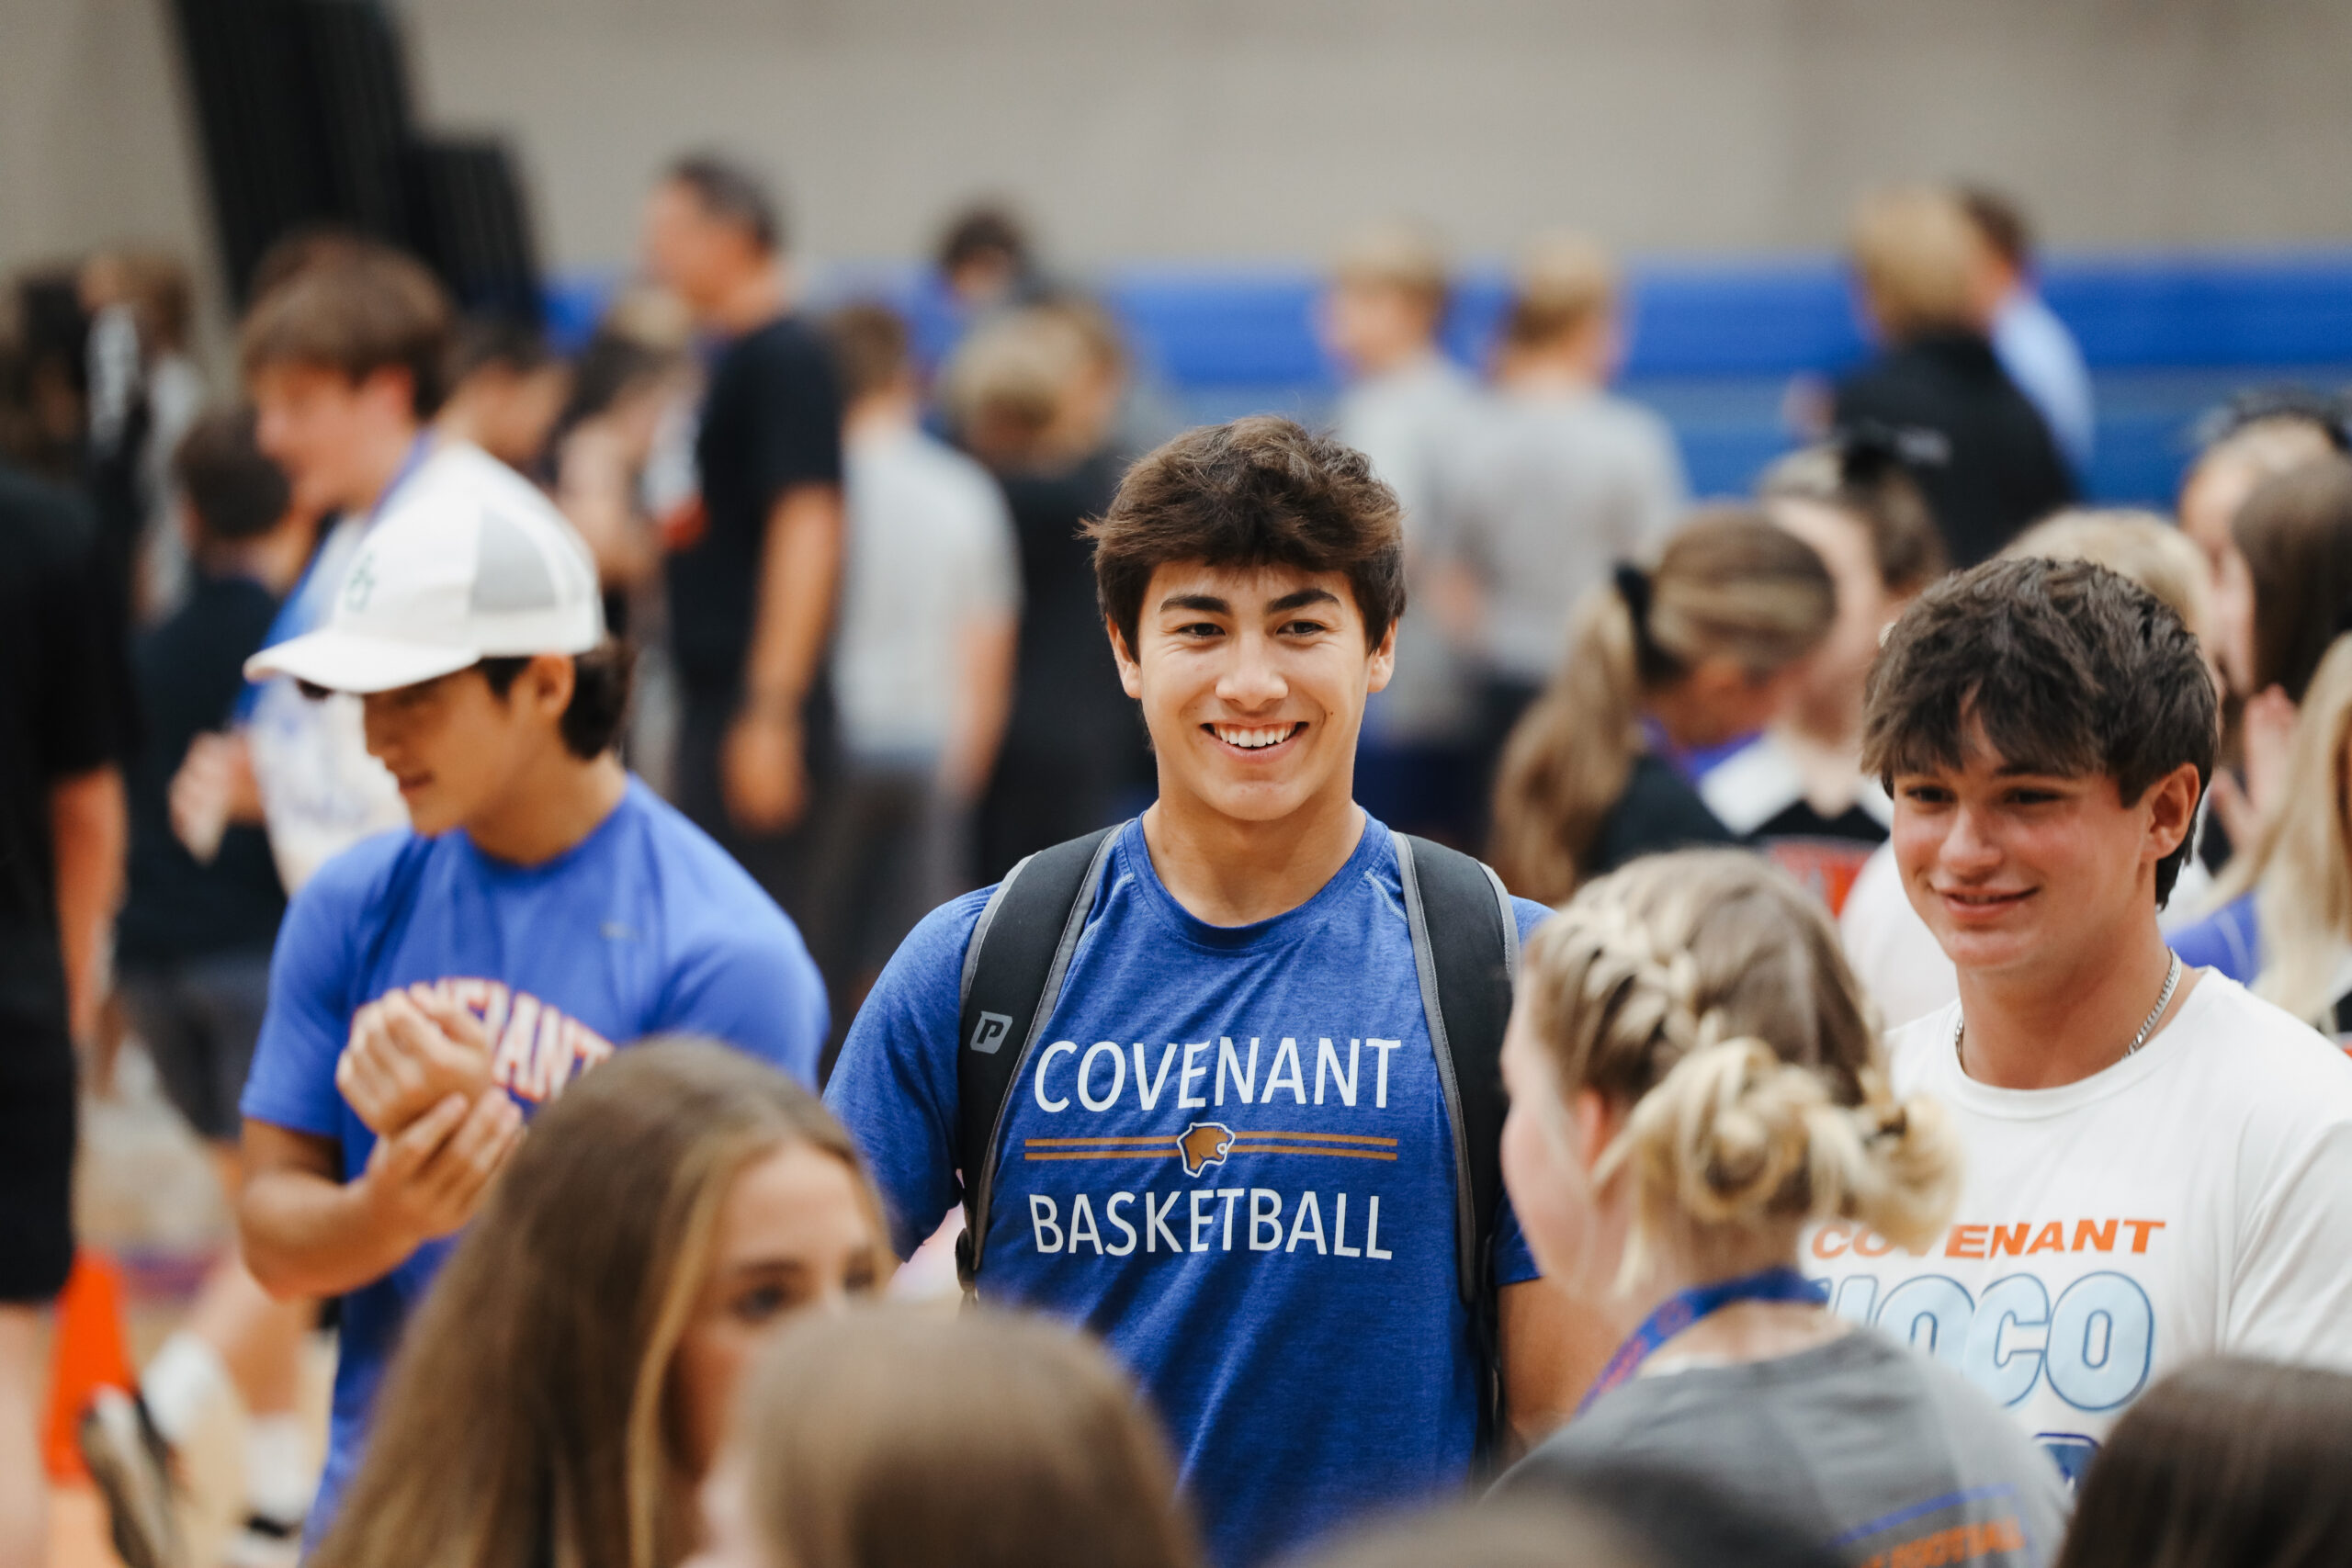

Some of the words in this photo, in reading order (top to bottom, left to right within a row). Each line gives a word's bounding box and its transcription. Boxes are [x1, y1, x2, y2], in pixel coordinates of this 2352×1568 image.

[975, 1017, 1007, 1046] P
[1034, 1036, 1402, 1112] COVENANT
[1029, 1188, 1393, 1260] BASKETBALL
[1811, 1219, 2166, 1259] COENANT
